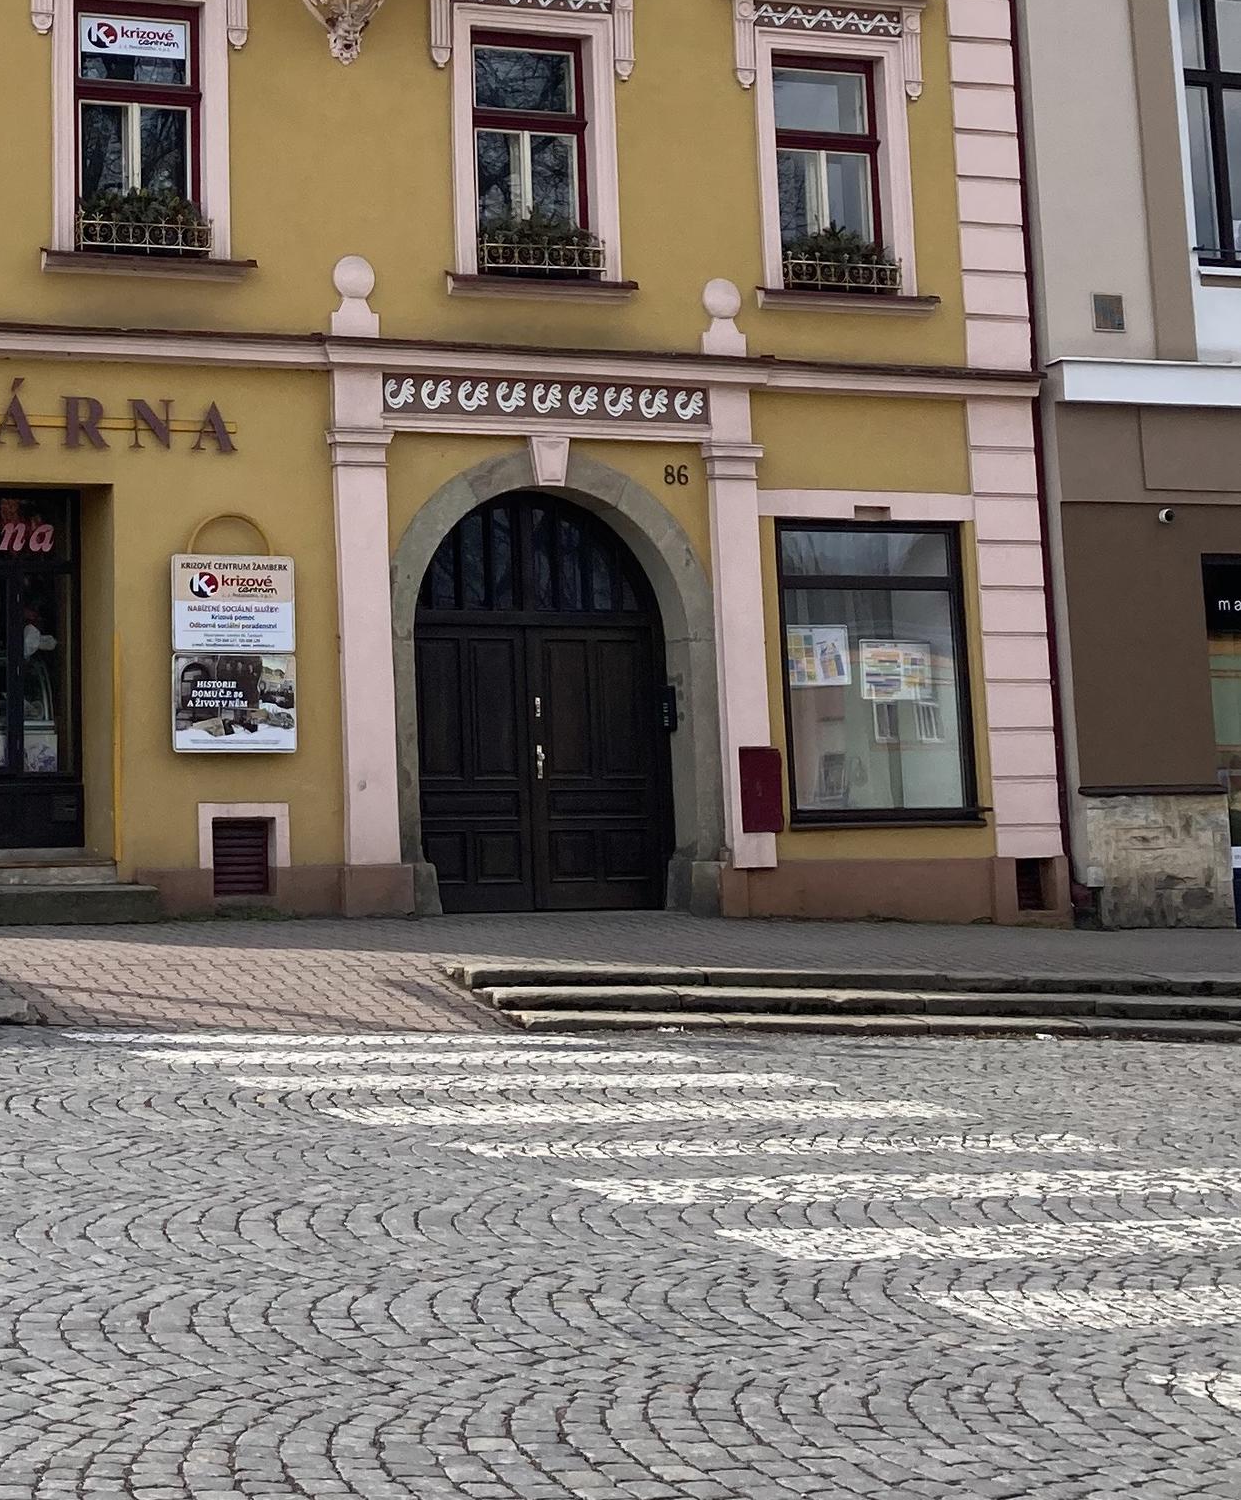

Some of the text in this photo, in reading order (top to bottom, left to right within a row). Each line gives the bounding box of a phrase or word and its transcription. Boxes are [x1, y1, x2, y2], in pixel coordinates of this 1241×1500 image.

[121, 26, 174, 40] krizové
[138, 38, 179, 48] centrum
[664, 464, 689, 486] 86
[181, 562, 288, 571] KRIZOVÉ CENTRUM ŽAMBERK
[221, 574, 273, 587] krizové
[238, 586, 277, 595] centrum
[222, 604, 253, 612] SOCIÁLNÍ
[191, 690, 218, 698] DOMU
[195, 698, 220, 707] ŽIVOT
[228, 699, 248, 708] NĚM
